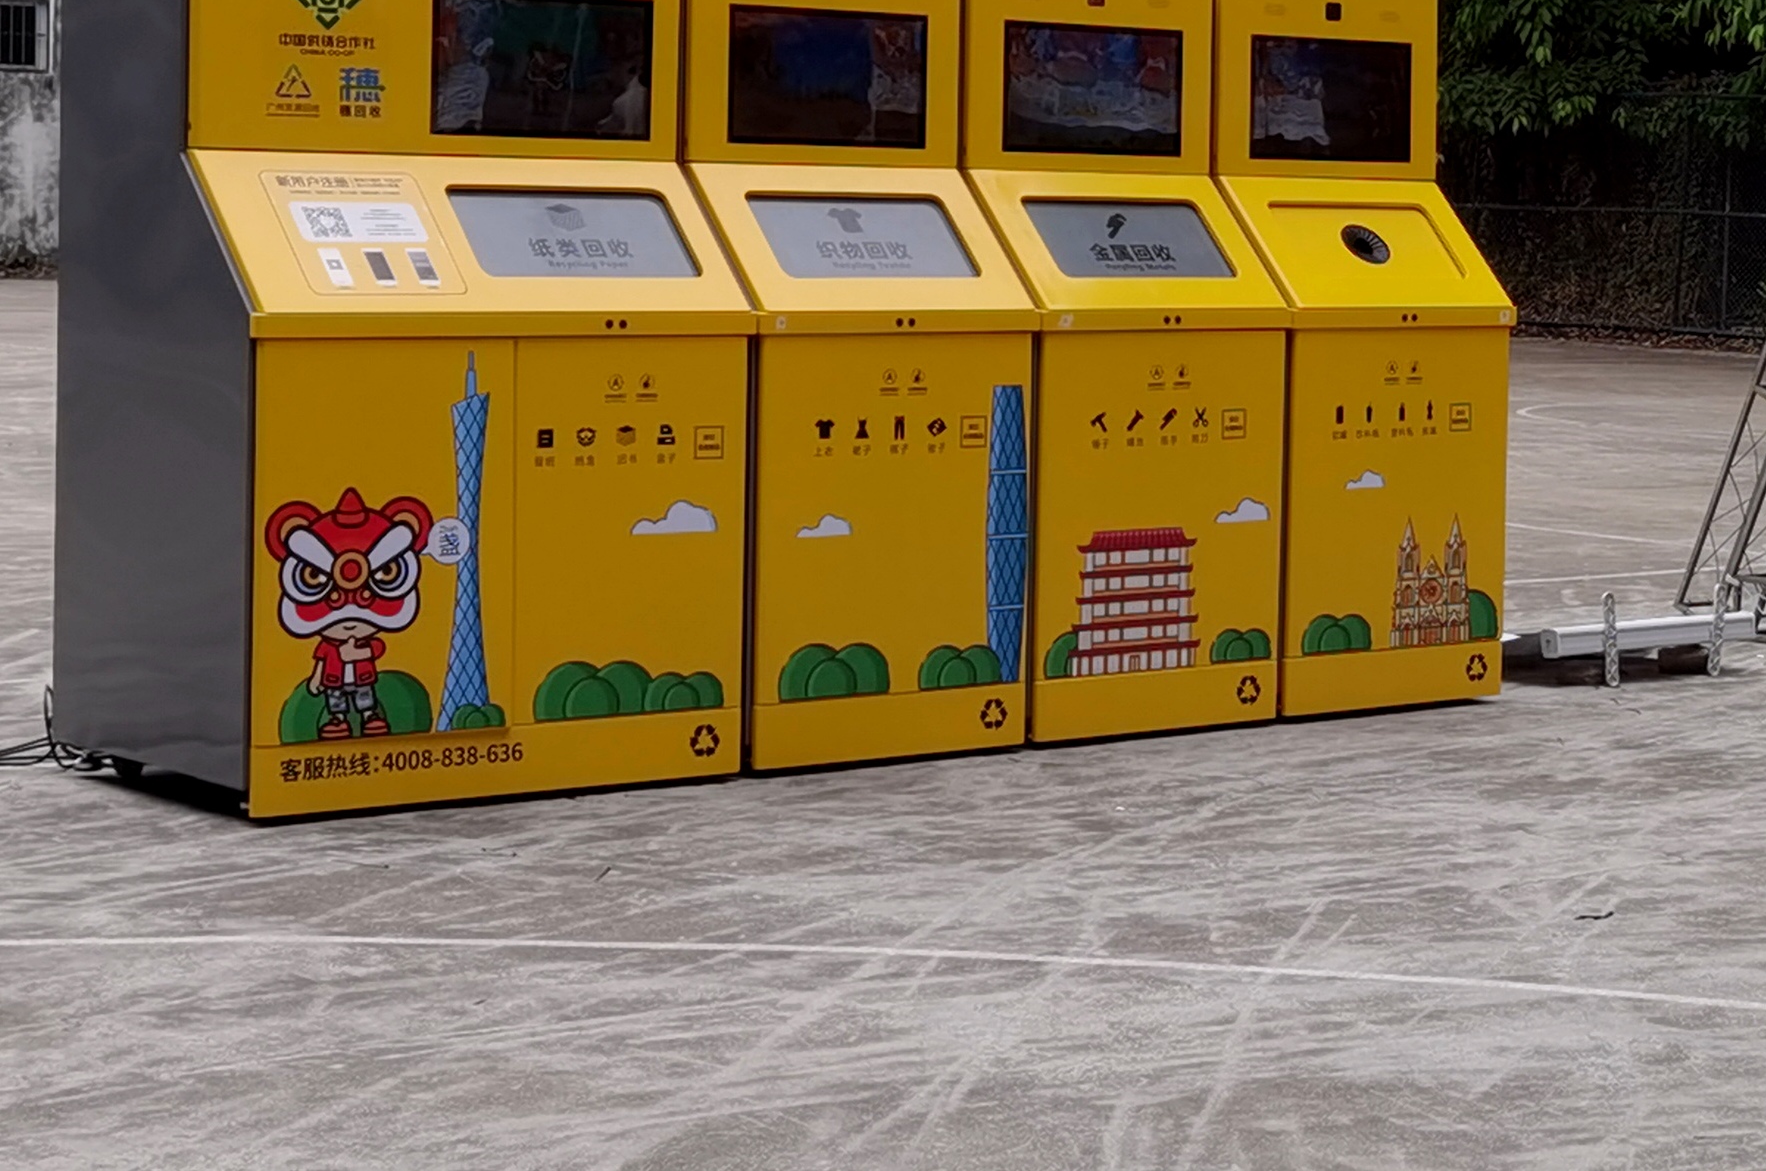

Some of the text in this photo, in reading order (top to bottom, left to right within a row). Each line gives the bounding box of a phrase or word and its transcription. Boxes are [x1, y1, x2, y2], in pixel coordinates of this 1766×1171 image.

[528, 237, 634, 259] 纸类回收
[816, 240, 914, 260] 织物回收
[1089, 243, 1177, 263] 金属回收
